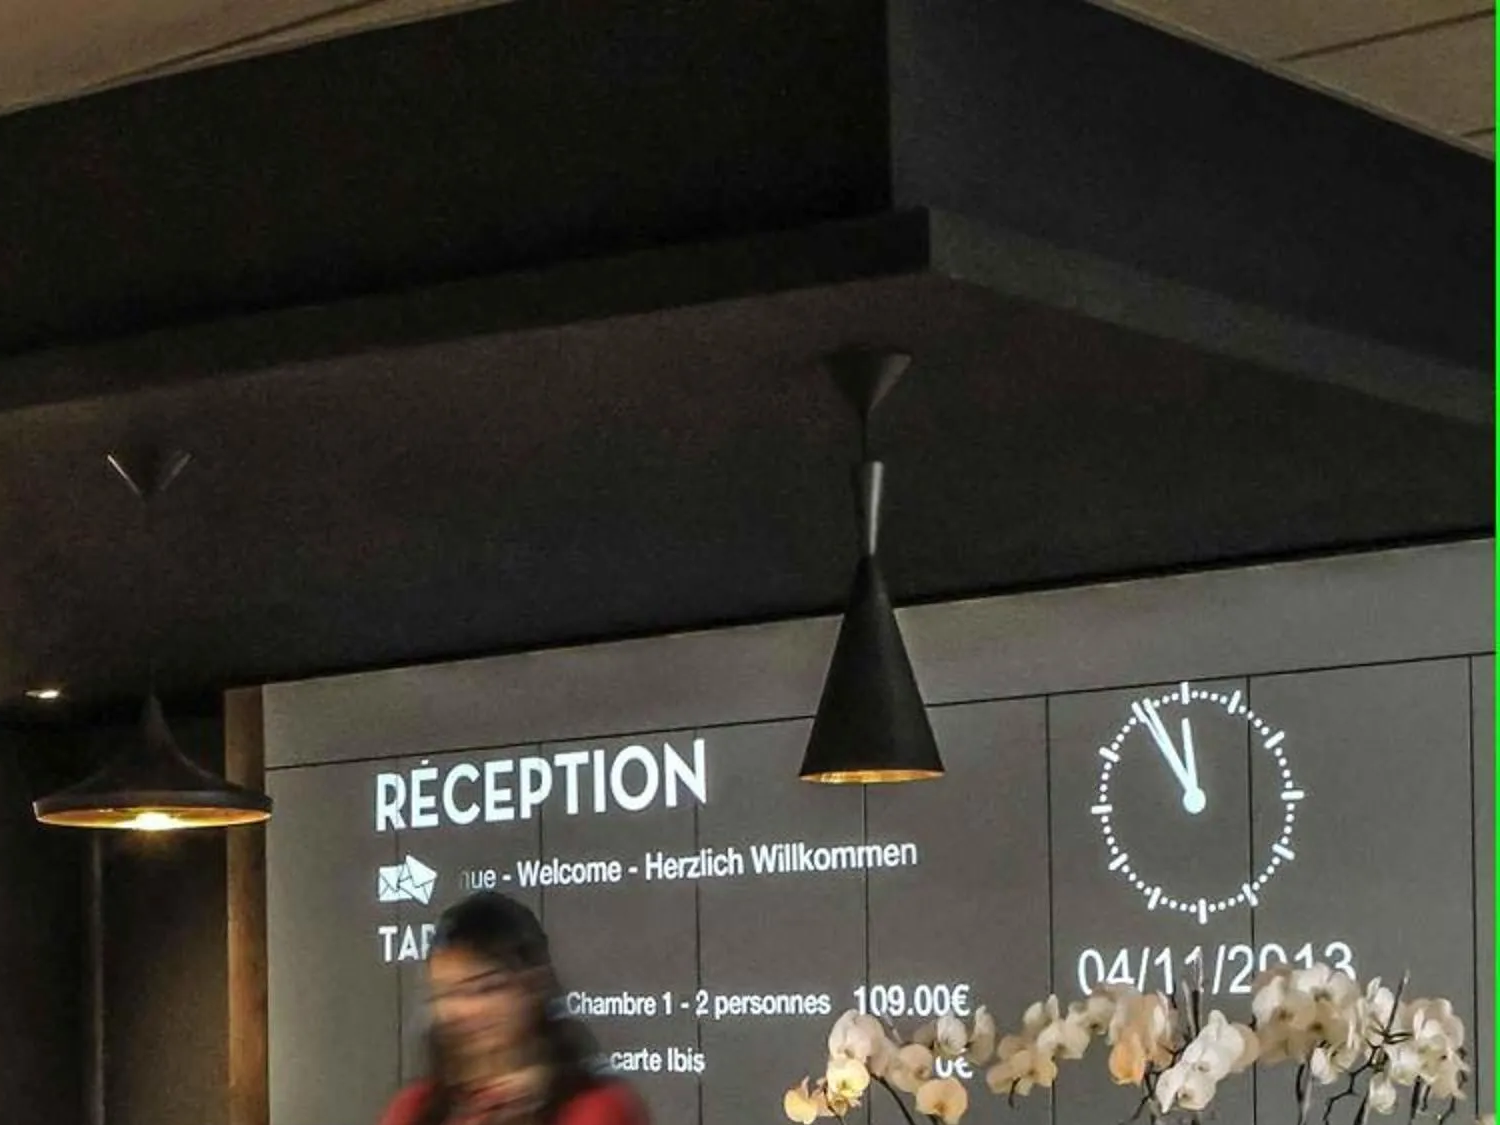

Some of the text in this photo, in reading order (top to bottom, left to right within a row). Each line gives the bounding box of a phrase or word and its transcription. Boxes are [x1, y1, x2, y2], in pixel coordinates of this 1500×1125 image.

[375, 738, 708, 832] RÉCEPTION
[516, 857, 622, 888] Welcome
[644, 845, 744, 882] Herzlich
[749, 840, 918, 874] Willkommen
[566, 991, 657, 1017] Chambre
[662, 991, 673, 1016] 1
[695, 990, 709, 1016] 2
[714, 993, 832, 1020] personnes
[853, 983, 971, 1017] 109.00€
[609, 1047, 706, 1073] carte Ibis
